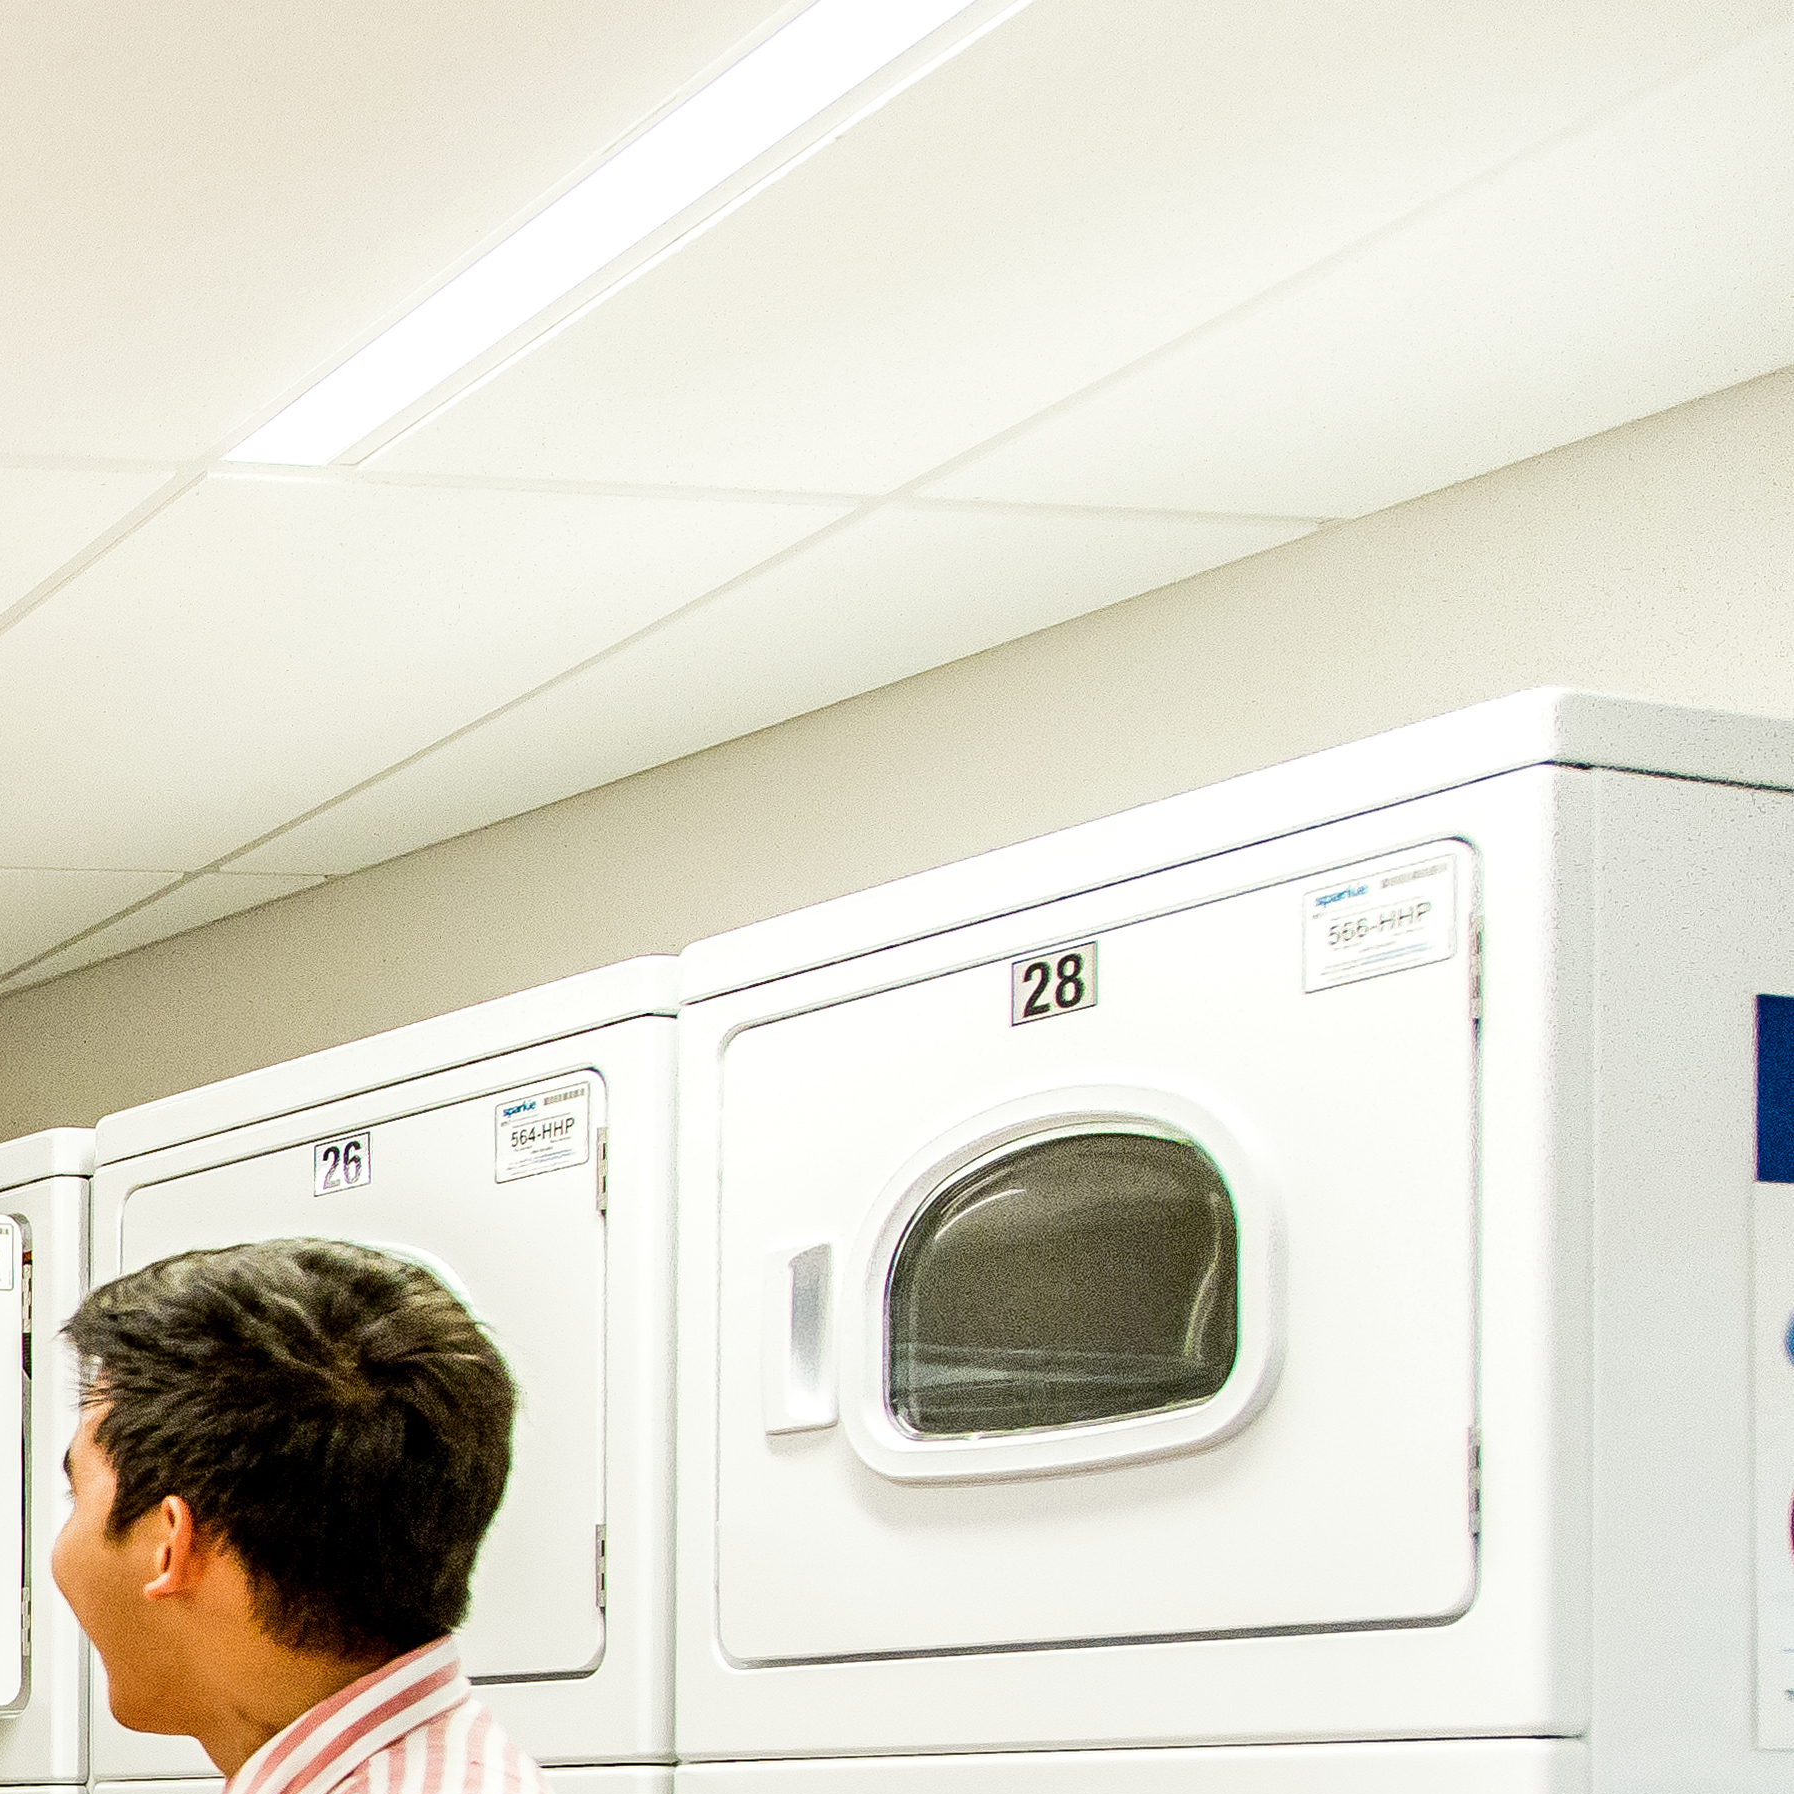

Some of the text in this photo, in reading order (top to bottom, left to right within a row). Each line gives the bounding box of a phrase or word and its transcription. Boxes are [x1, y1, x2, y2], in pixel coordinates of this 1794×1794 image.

[1021, 954, 1085, 1017] 28
[511, 1117, 575, 1147] 564-HHP
[321, 1139, 364, 1190] 26
